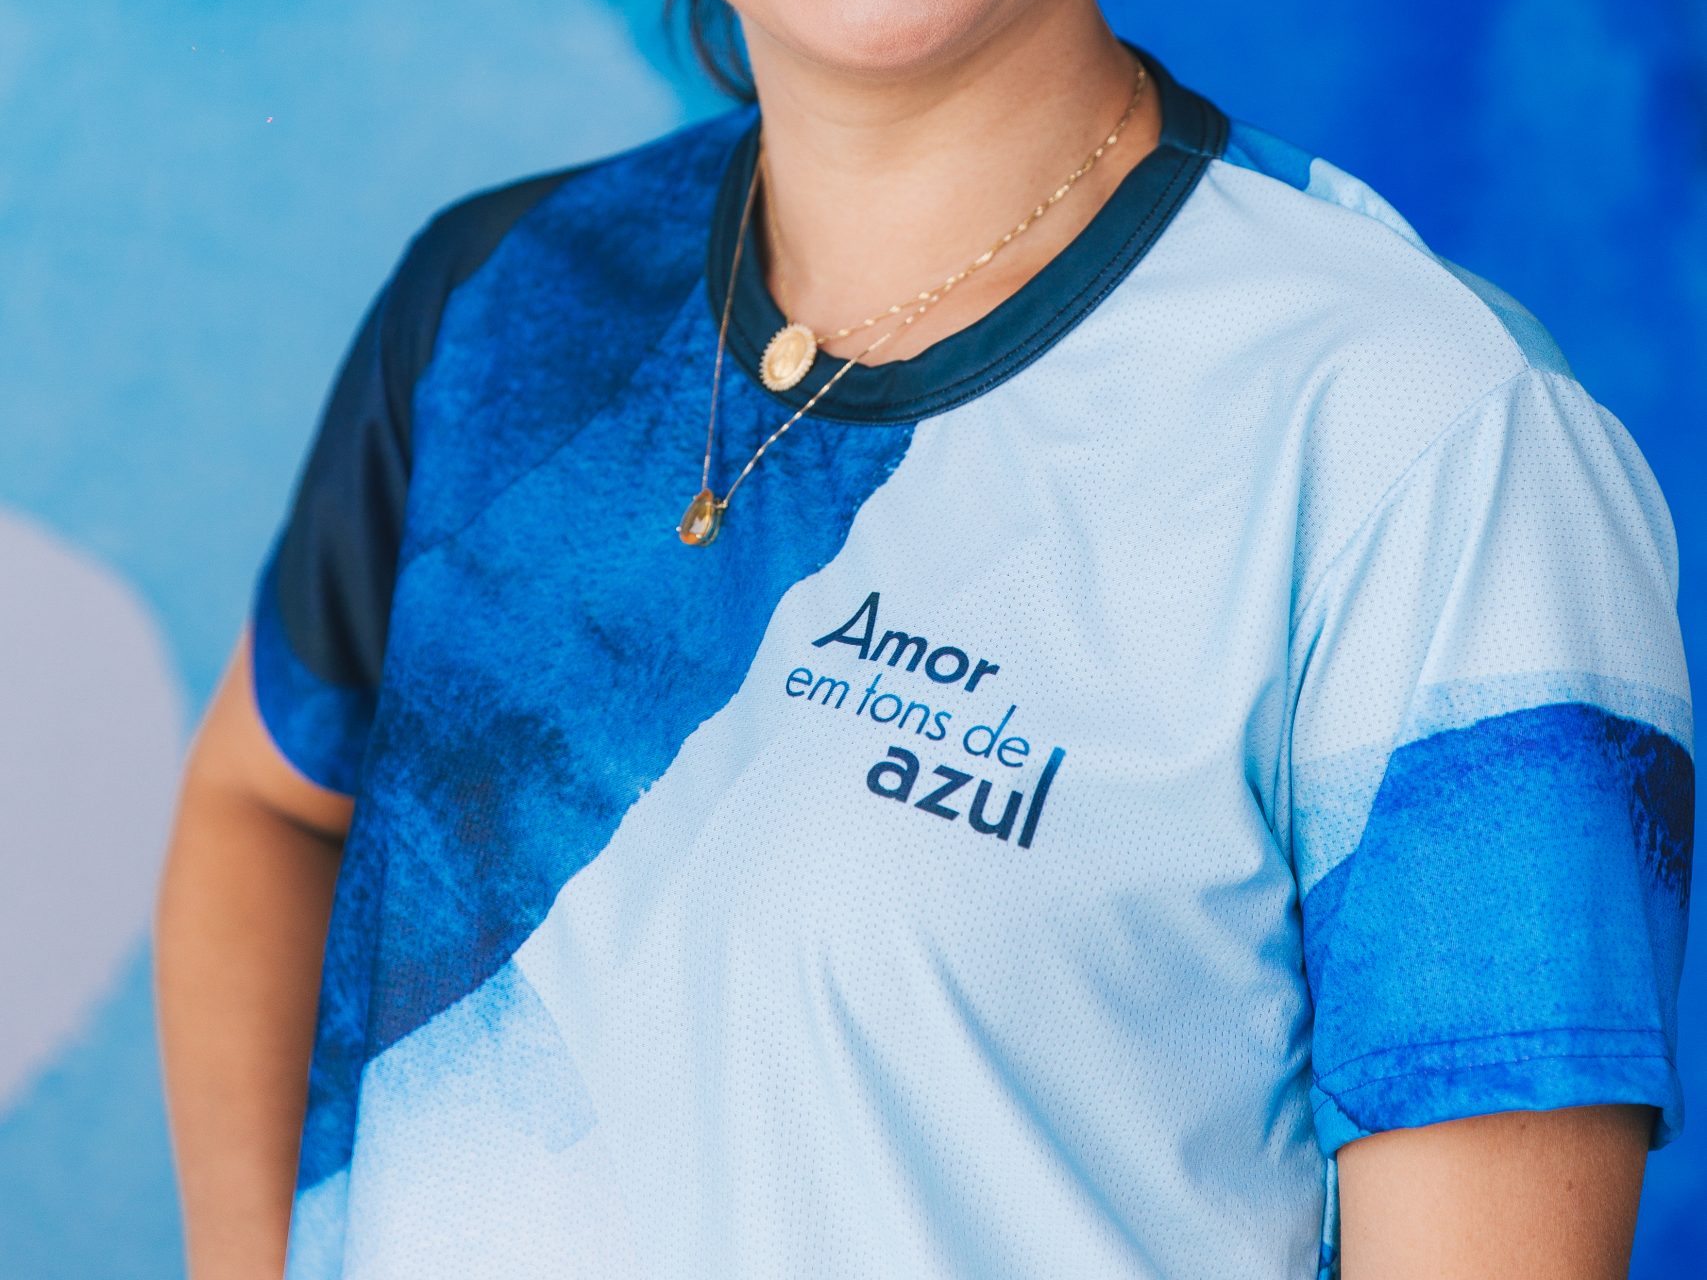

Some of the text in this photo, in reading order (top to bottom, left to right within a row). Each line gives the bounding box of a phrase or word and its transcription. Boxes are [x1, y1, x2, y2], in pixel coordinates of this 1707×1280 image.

[811, 591, 1000, 693] Amor
[785, 666, 1031, 768] em tons de
[866, 745, 1067, 850] azul
